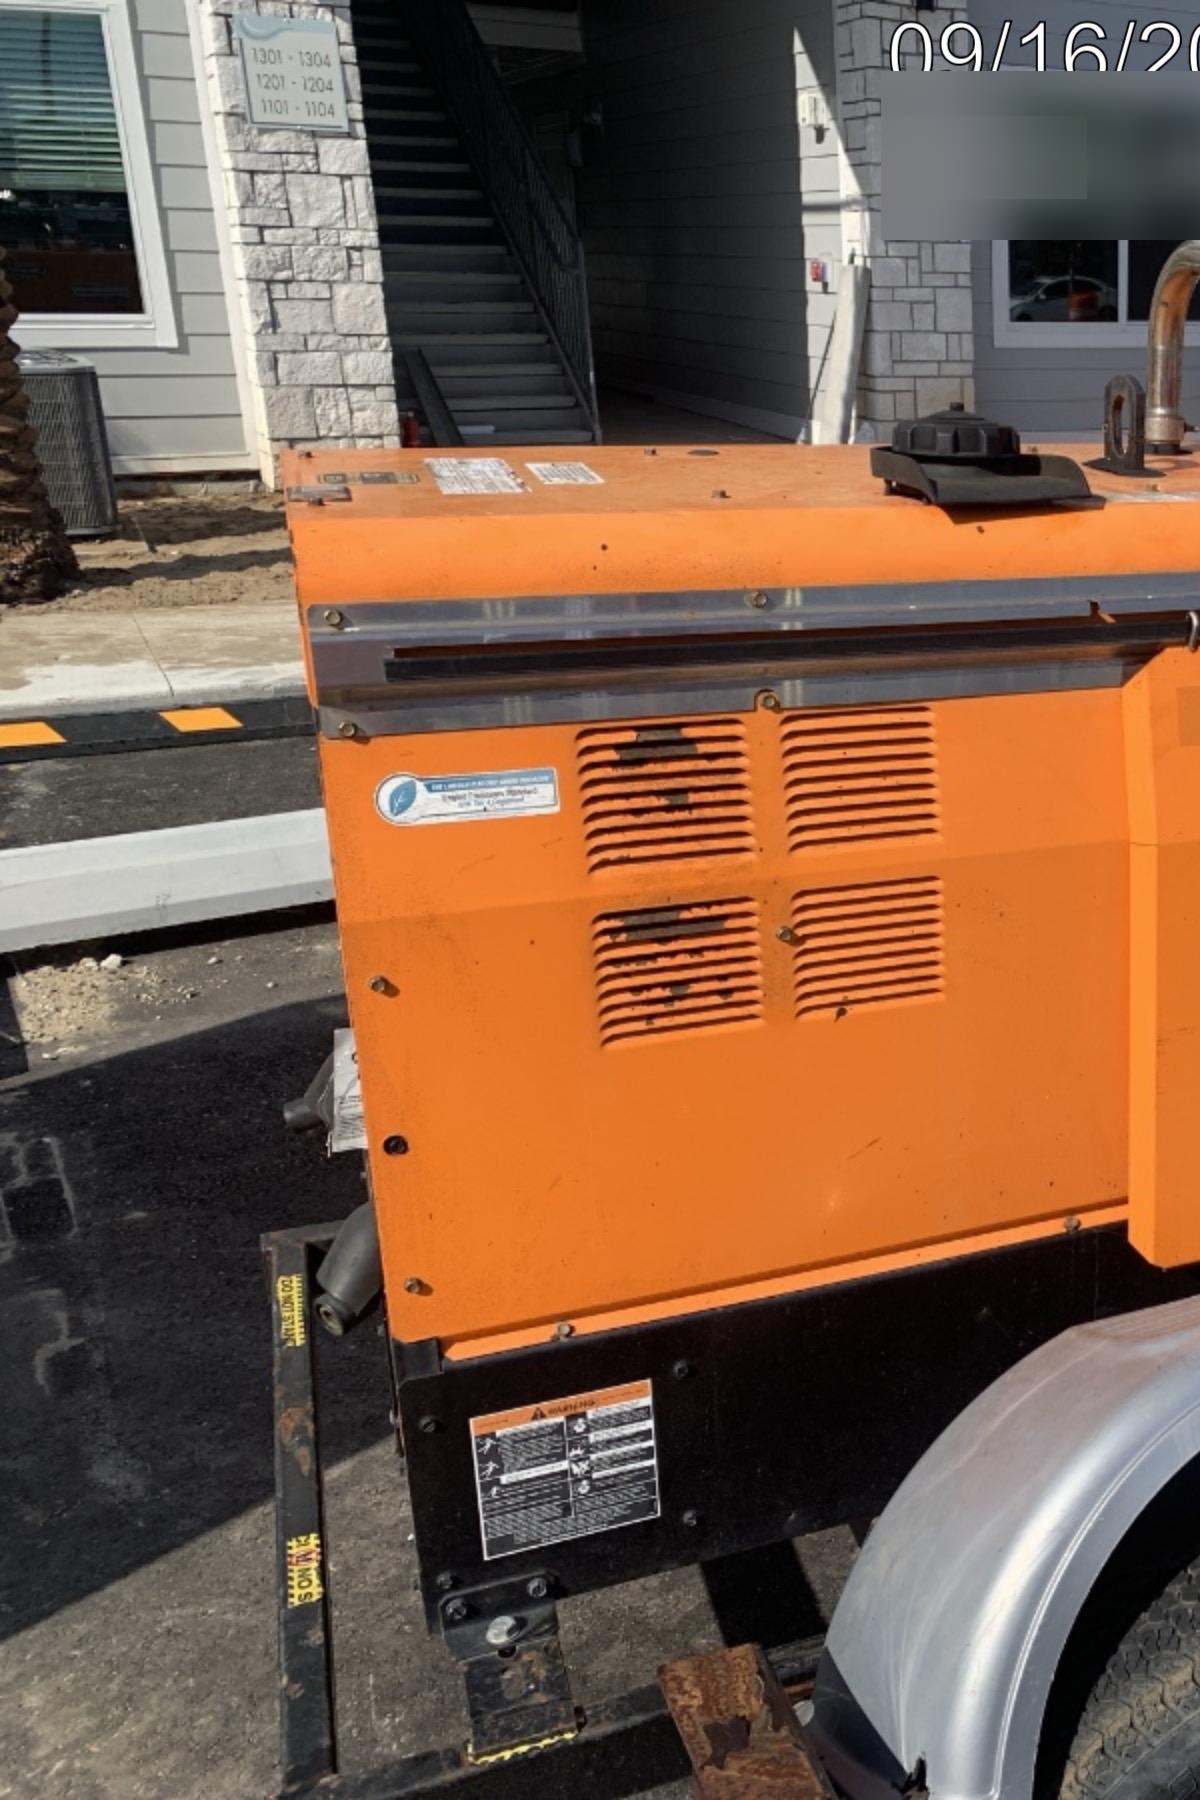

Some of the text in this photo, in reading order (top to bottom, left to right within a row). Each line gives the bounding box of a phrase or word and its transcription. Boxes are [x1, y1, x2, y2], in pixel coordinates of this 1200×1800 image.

[253, 48, 283, 64] 1301
[299, 52, 332, 68] 1304
[256, 74, 286, 90] 1201
[302, 76, 334, 92] 1204
[261, 99, 289, 114] 1101
[304, 101, 335, 117] 1104
